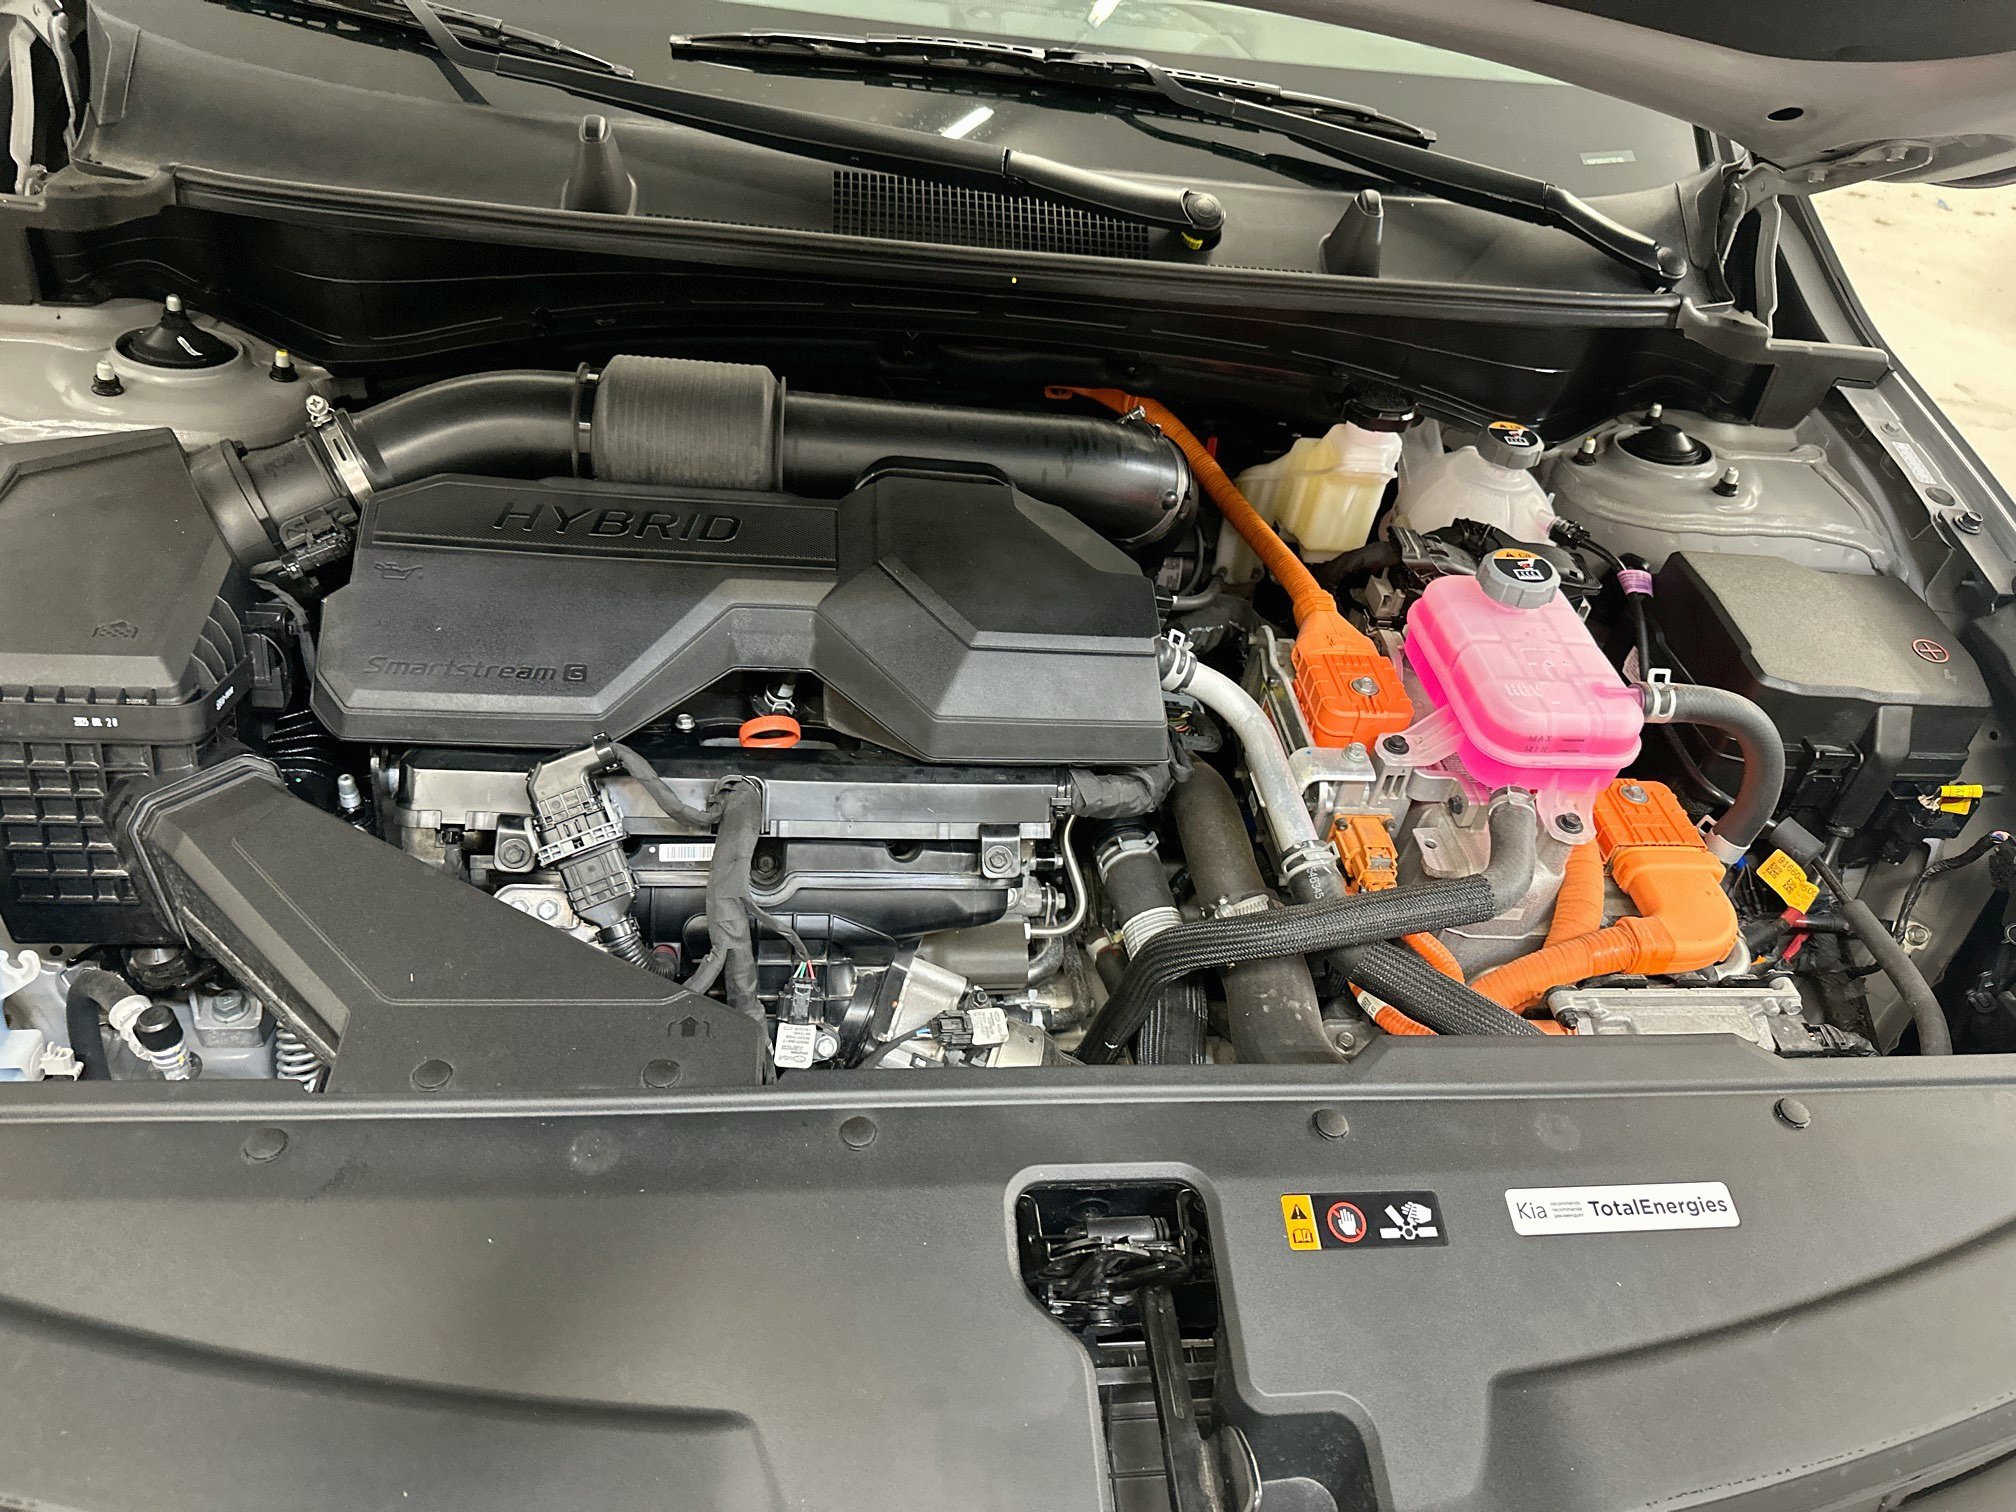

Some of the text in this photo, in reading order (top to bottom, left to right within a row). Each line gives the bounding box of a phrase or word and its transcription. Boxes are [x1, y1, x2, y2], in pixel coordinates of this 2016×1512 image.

[492, 502, 743, 543] HYBRID
[364, 656, 558, 681] Smartstream
[1523, 745, 1549, 753] MIN
[1528, 735, 1552, 743] MAX
[1516, 1196, 1728, 1219] Kia TotalEnergies
